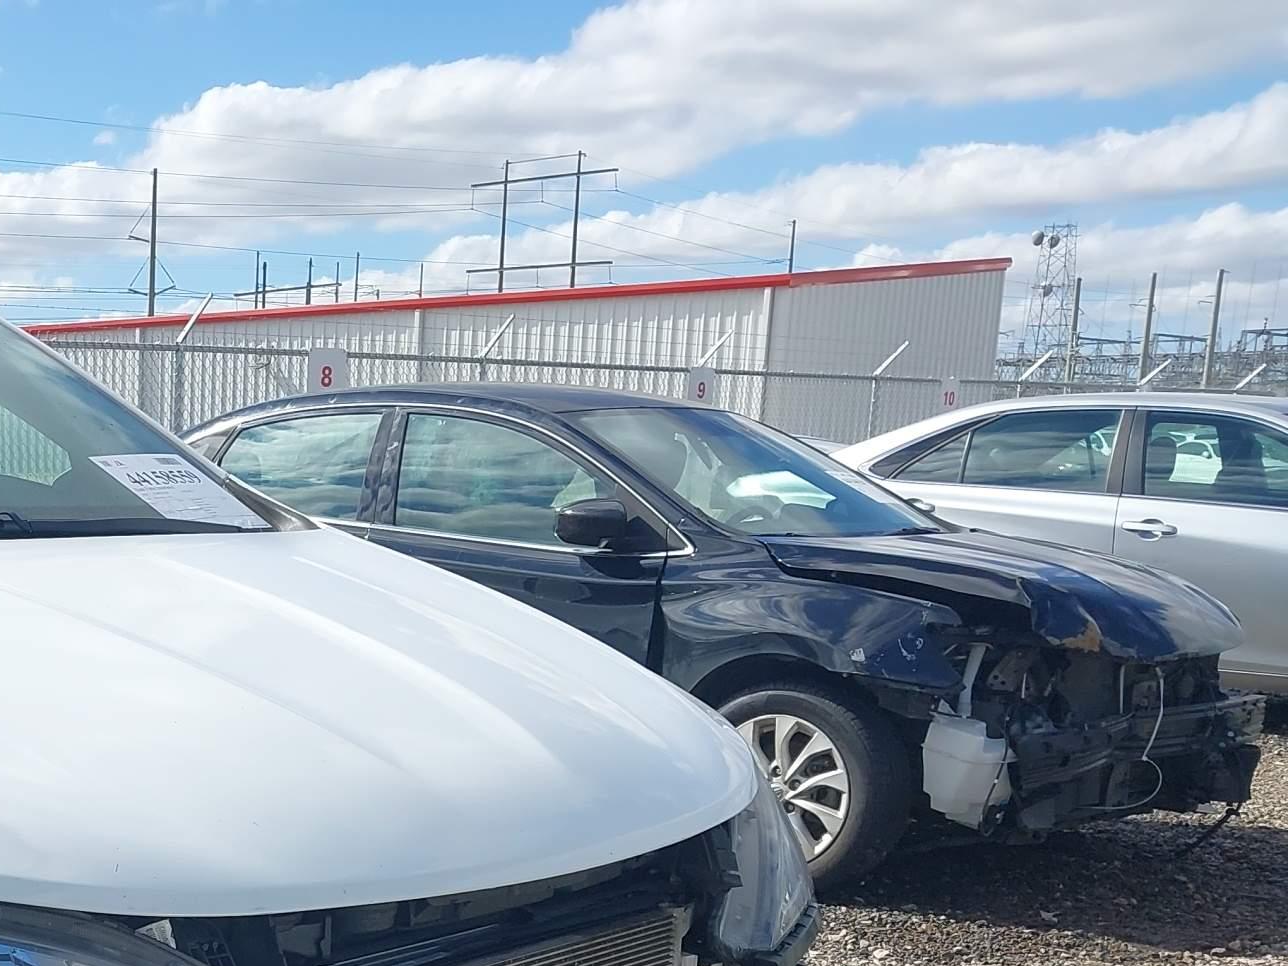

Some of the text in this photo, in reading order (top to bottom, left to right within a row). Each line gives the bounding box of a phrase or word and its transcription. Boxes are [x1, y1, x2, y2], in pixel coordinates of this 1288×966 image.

[321, 366, 332, 387] 8
[697, 382, 705, 399] 9
[944, 391, 955, 406] 10
[126, 469, 202, 487] 44158559
